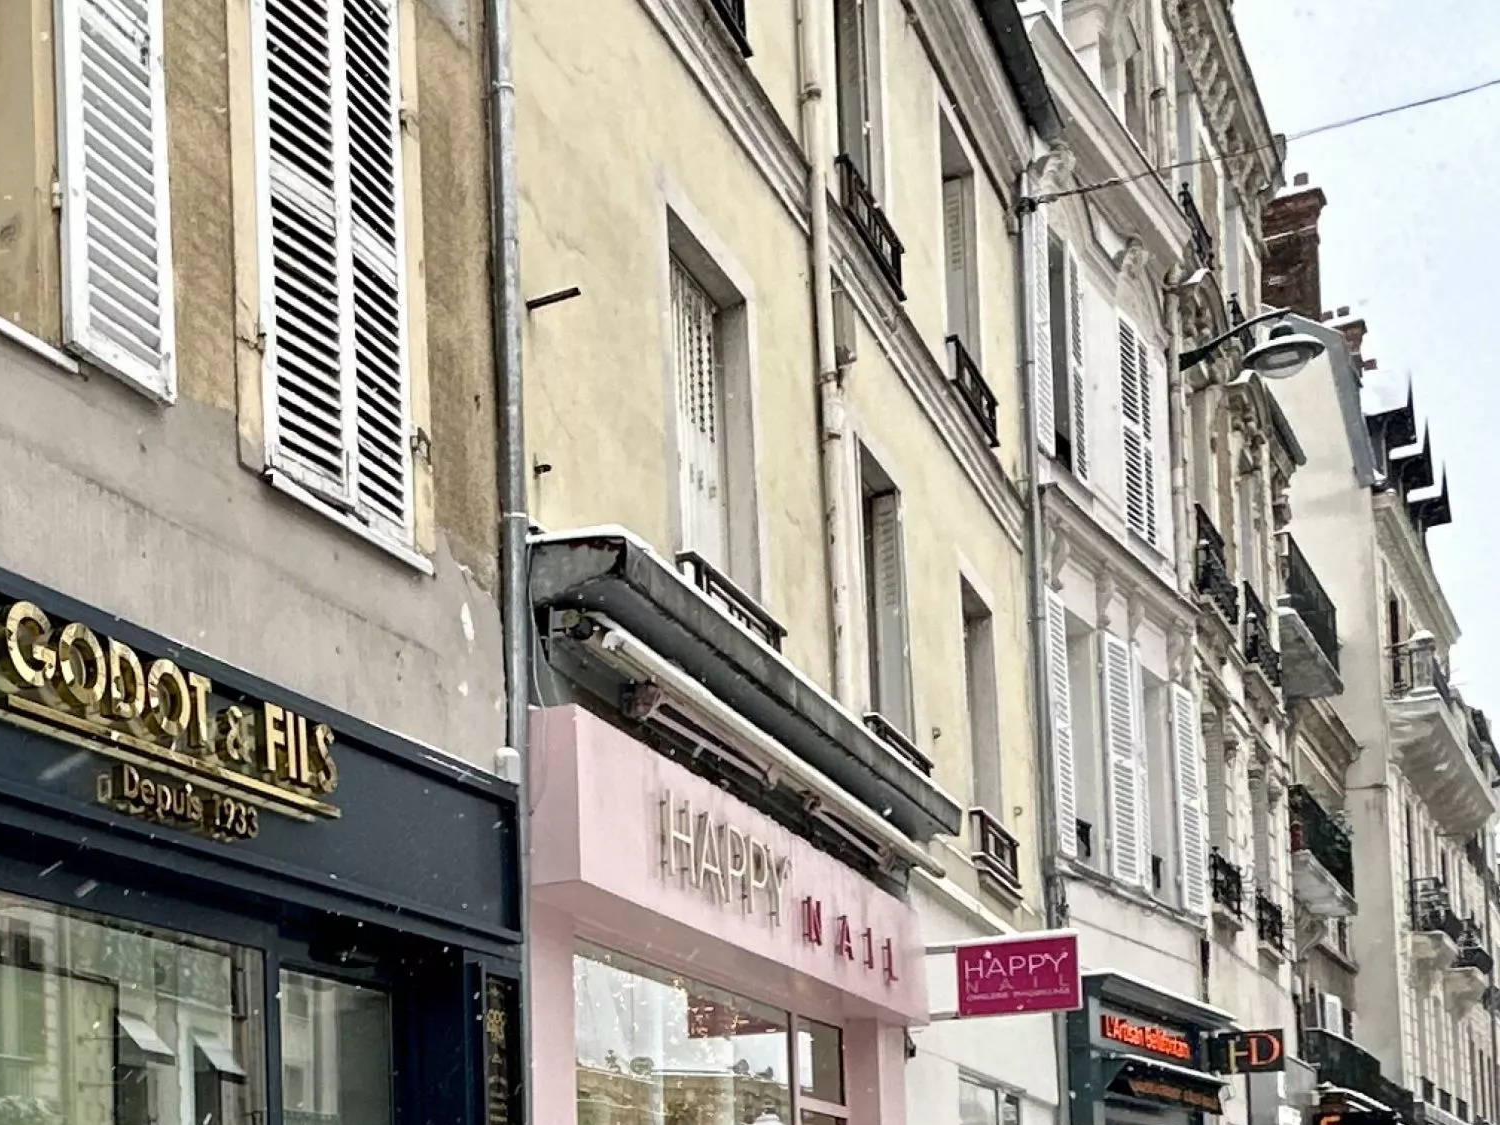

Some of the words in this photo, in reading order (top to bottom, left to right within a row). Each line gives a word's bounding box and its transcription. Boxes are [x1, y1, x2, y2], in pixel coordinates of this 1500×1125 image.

[4, 600, 213, 742] GODOT
[226, 704, 254, 763] &
[263, 702, 339, 794] FILS
[123, 763, 203, 821] Depuis
[211, 793, 259, 839] 1933
[663, 789, 793, 928] HAPPY
[803, 896, 899, 986] NAIL
[964, 952, 1069, 979] HAPPY
[965, 973, 1070, 993] NAIL
